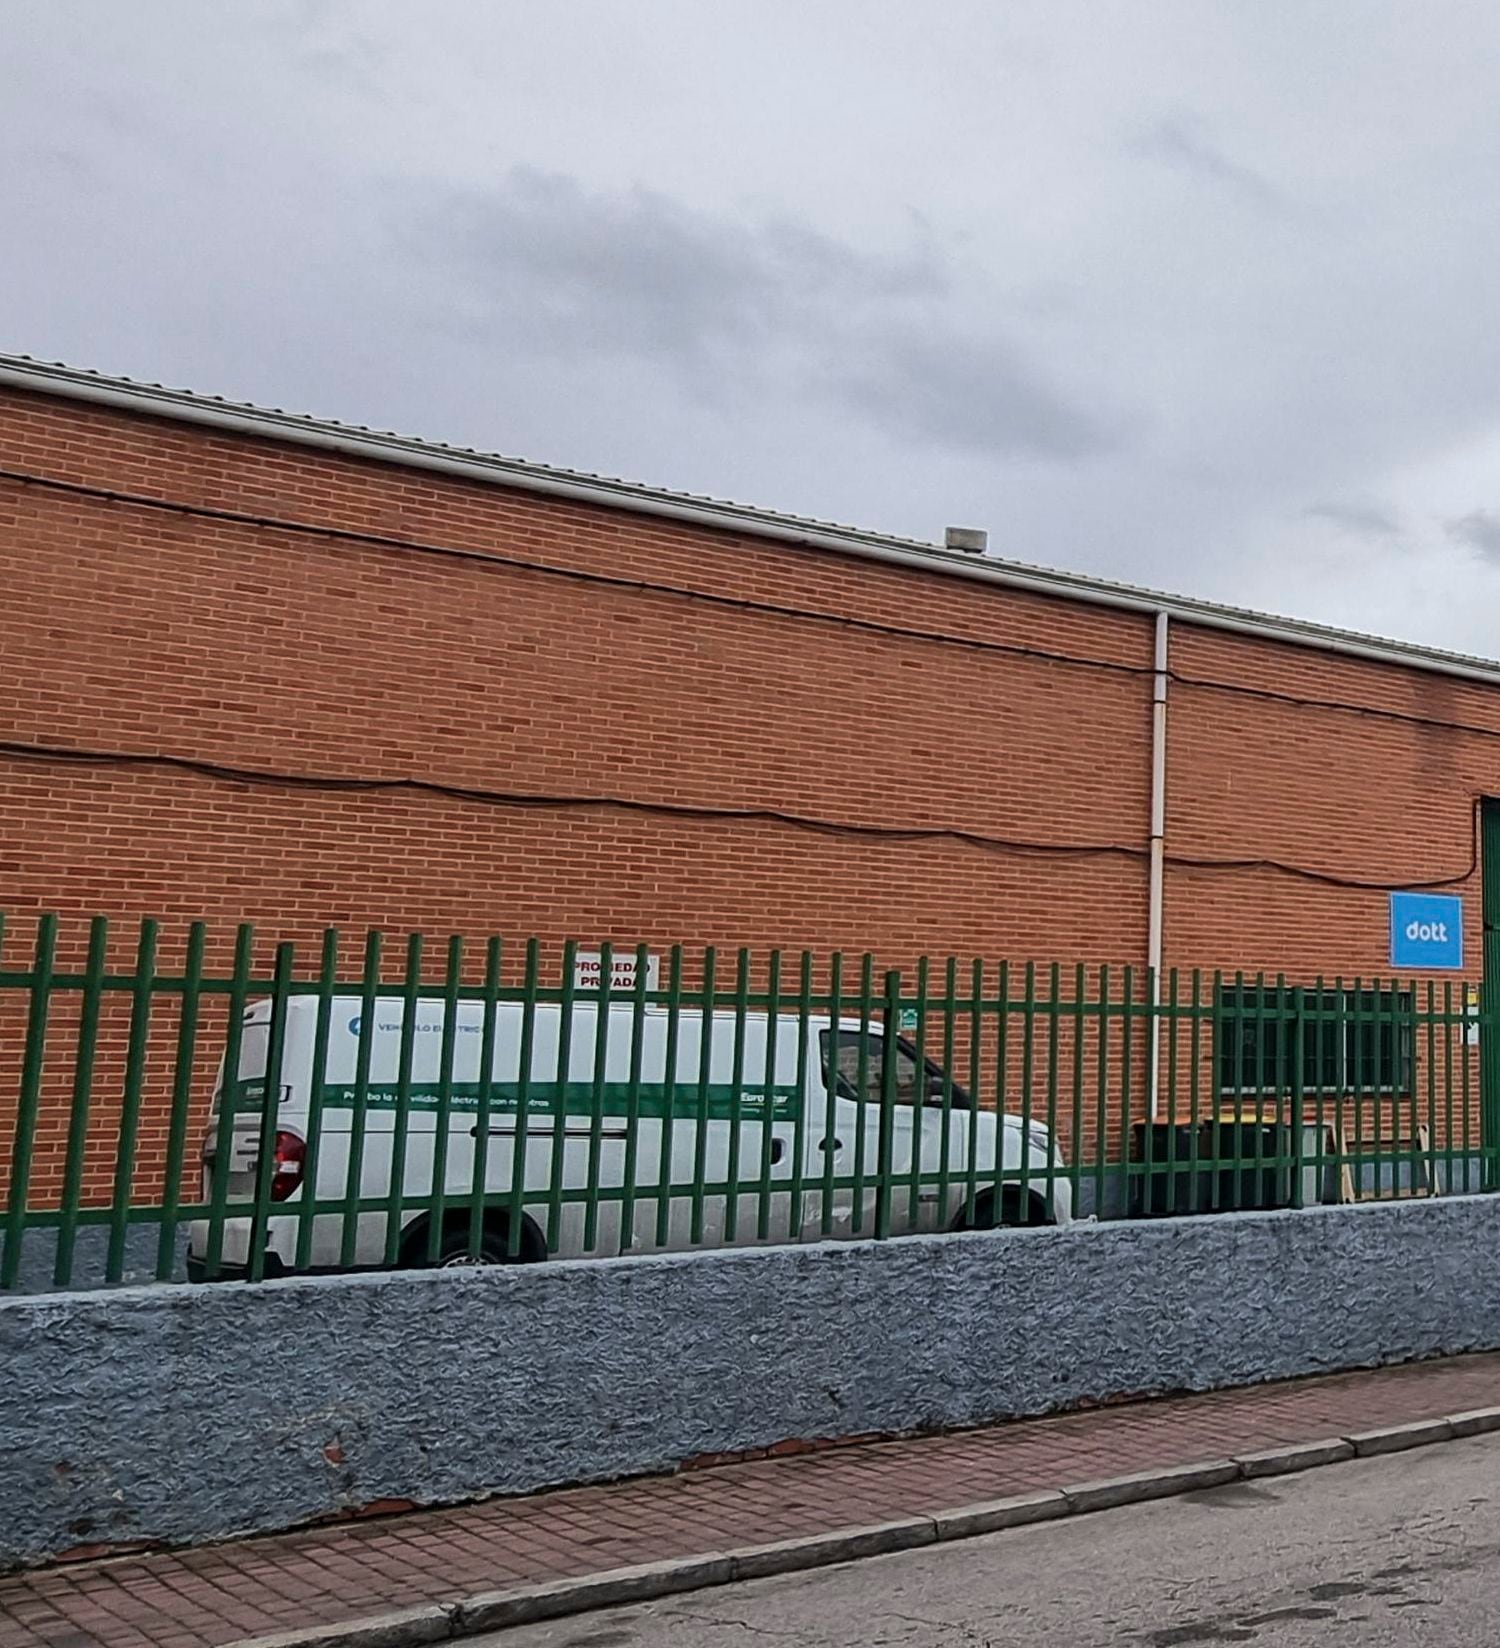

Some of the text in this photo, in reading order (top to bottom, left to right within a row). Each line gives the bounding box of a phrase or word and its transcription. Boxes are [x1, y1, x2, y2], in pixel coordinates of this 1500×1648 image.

[1406, 920, 1448, 942] dott
[580, 976, 640, 988] PRAD
[378, 1023, 431, 1033] VEHLO
[343, 1091, 381, 1102] Prba
